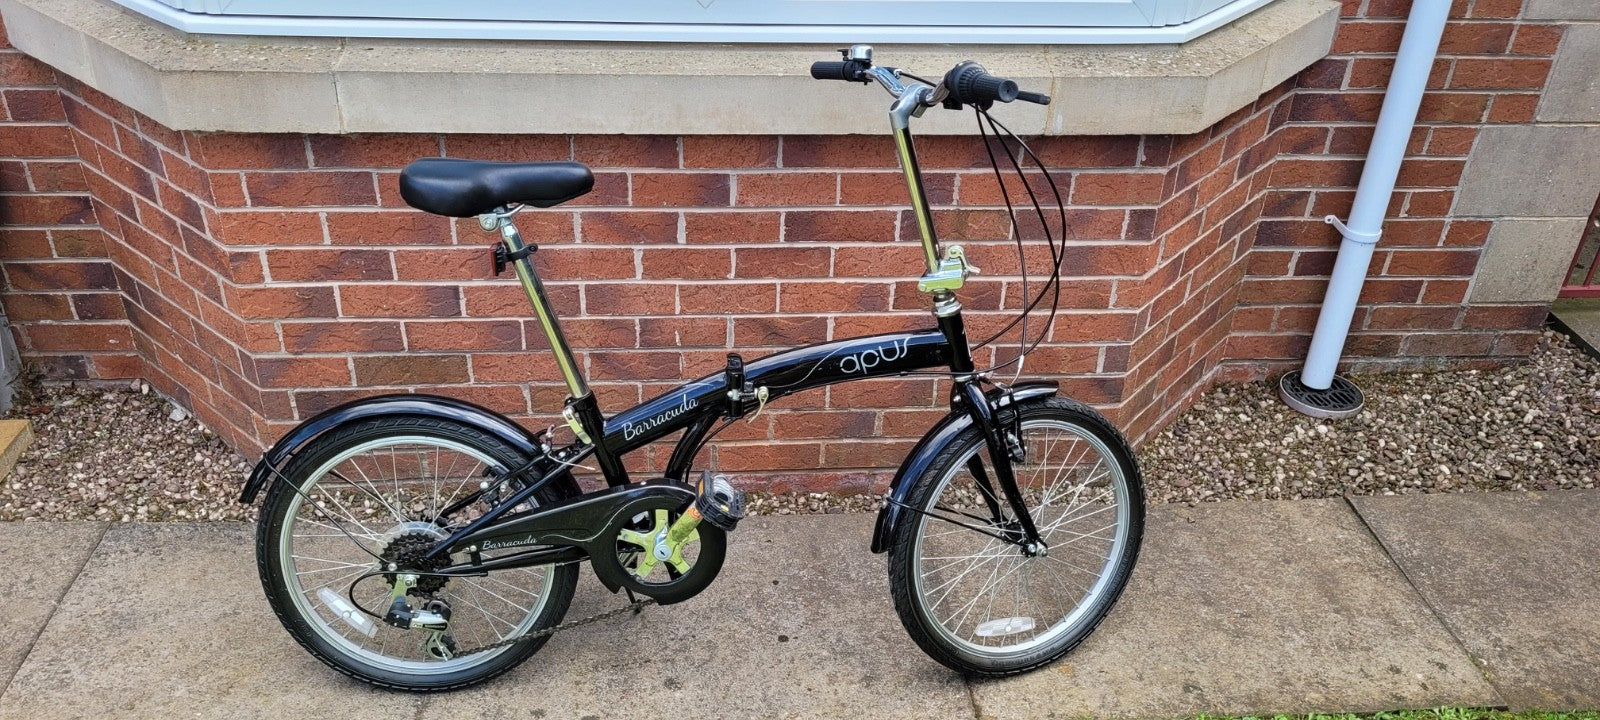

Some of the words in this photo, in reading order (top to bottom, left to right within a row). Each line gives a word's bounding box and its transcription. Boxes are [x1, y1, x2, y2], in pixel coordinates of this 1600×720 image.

[840, 336, 911, 375] apus
[621, 393, 699, 441] Barracuda
[482, 534, 538, 550] Barracuda
